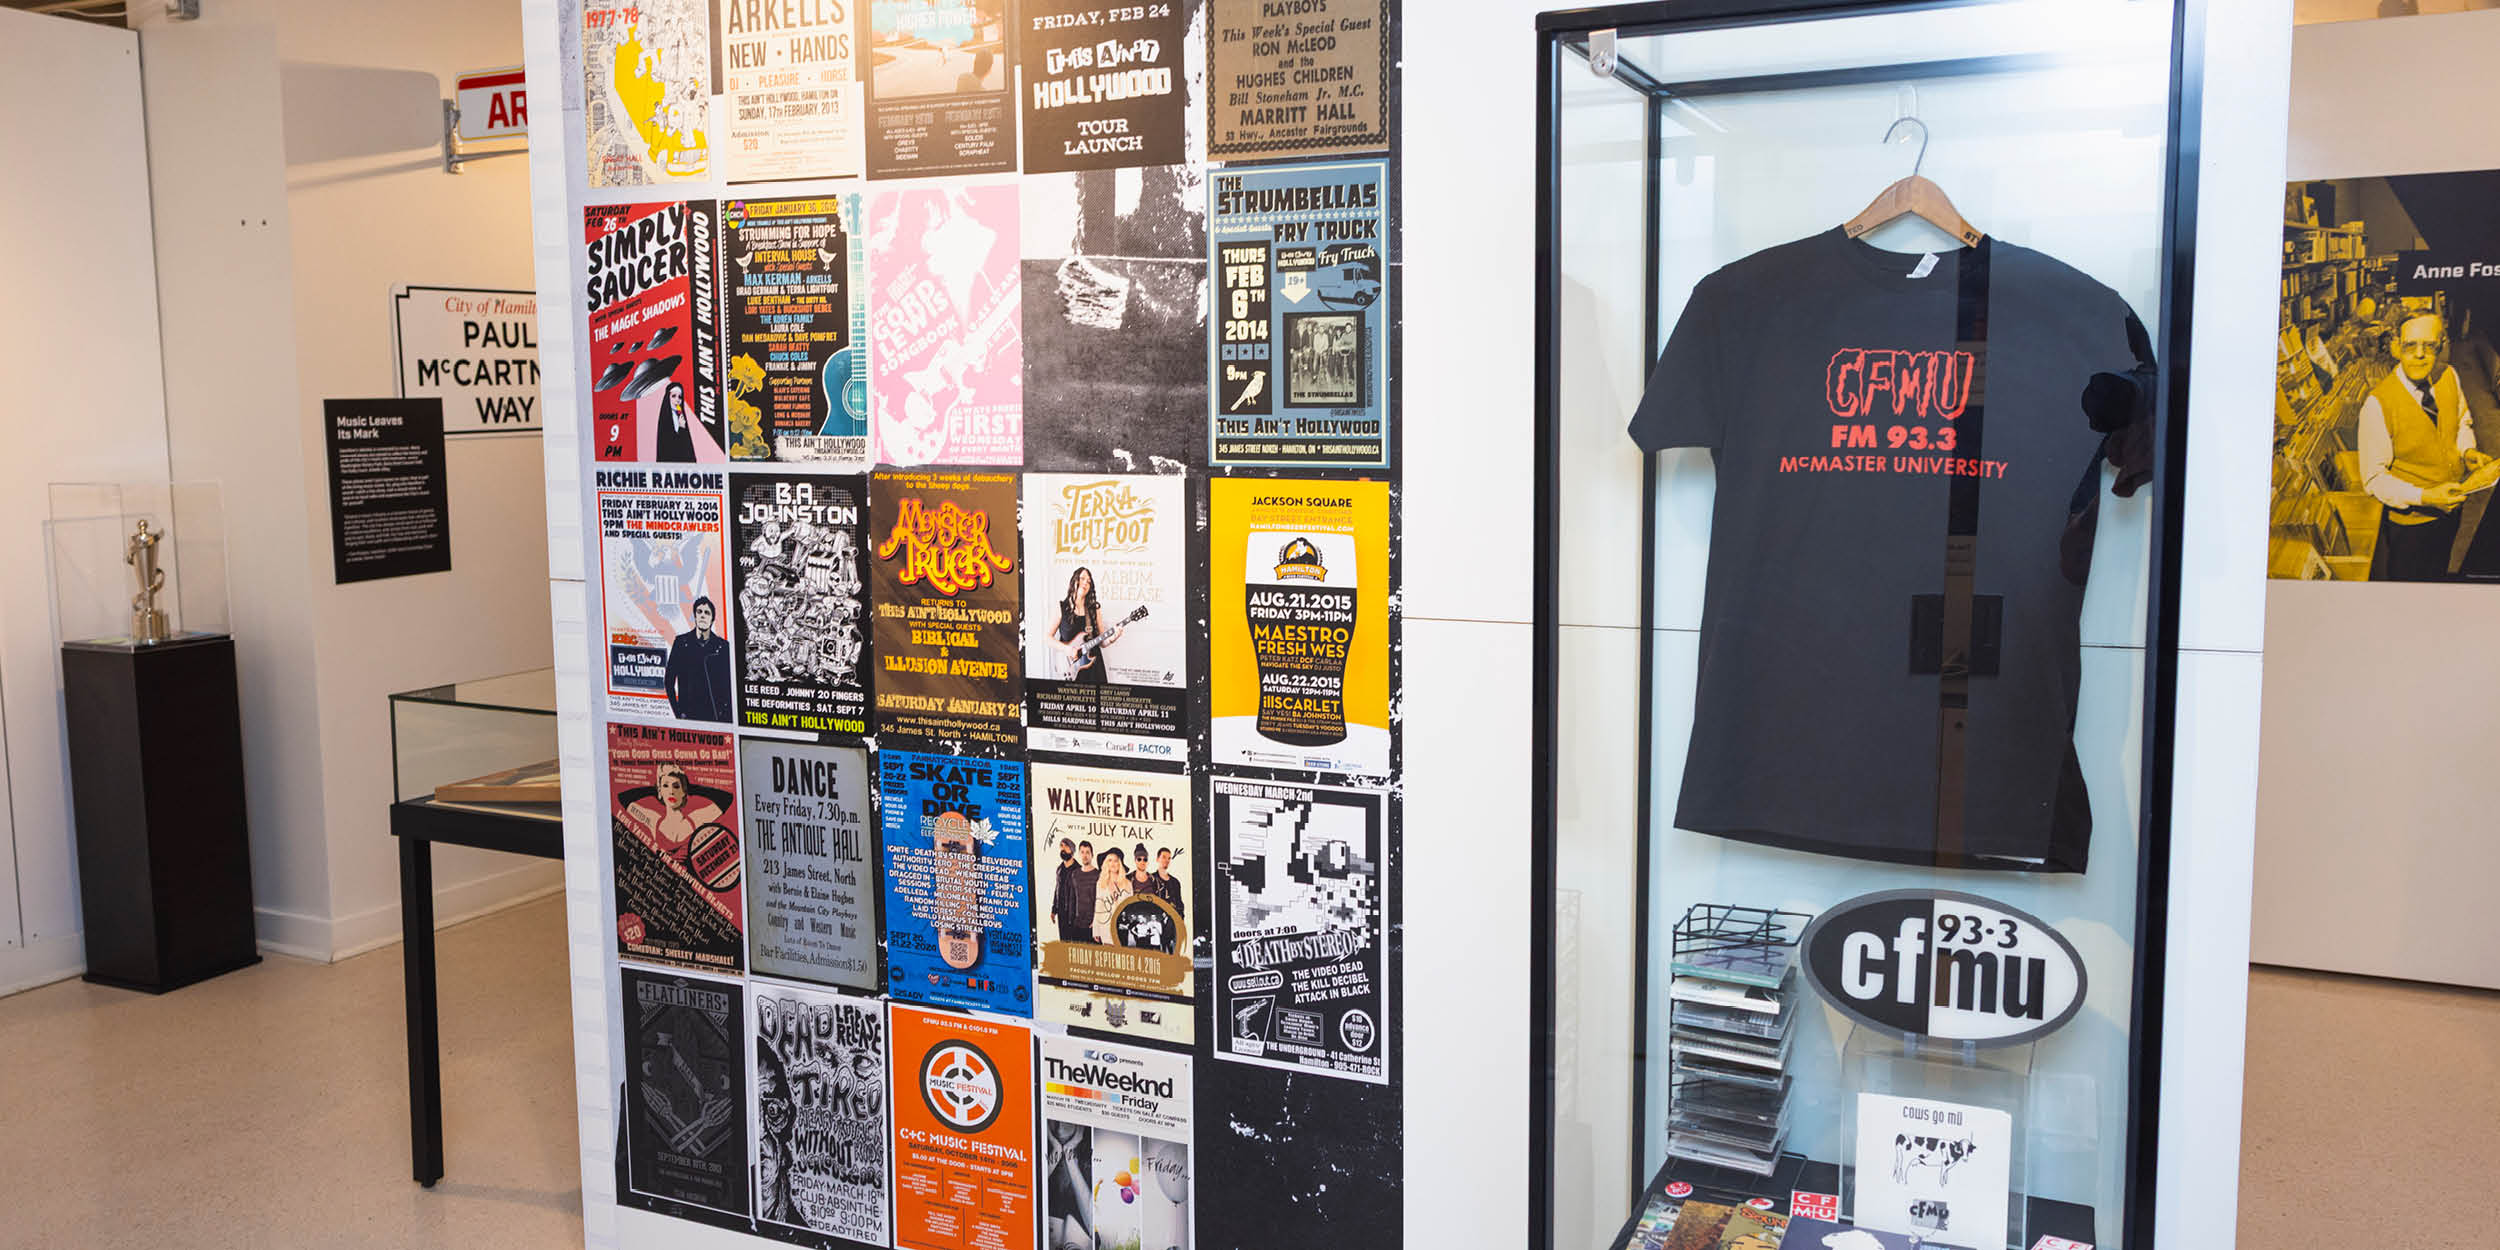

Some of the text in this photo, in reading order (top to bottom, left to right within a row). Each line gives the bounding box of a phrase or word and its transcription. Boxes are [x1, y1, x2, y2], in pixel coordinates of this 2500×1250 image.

[729, 0, 846, 34] ARKELLS
[1033, 4, 1171, 30] FRIDAY, FEB 24
[1263, 0, 1327, 17] PLAYBOYS
[1222, 18, 1371, 42] This Week's Special Guest
[729, 34, 849, 69] NEW HANDS
[1252, 37, 1336, 57] RON McLEOD
[1236, 66, 1353, 89] HUGHES CHILDREN
[1033, 67, 1172, 110] HOLLYWOOD
[1229, 90, 1309, 107] Bill Stoneham
[1240, 103, 1355, 126] MARRITT HALL
[1063, 118, 1143, 155] TOUR LAUNCH
[1269, 121, 1368, 138] Ancaster Fairgrounds
[1218, 176, 1379, 216] THE STRUMBELLAS
[588, 204, 684, 275] SIMPLY
[739, 224, 837, 241] STRUMMING HOPE
[1274, 221, 1310, 243] FRY
[1315, 218, 1379, 241] TRUCK
[1223, 247, 1266, 264] THURS
[1318, 245, 1375, 267] Fry Truck
[588, 242, 687, 313] SAUCER
[692, 211, 713, 328] HOLLYWOOD
[744, 272, 802, 286] MAX KERMAN
[1226, 264, 1264, 288] FEB
[2413, 264, 2464, 279] Anne
[444, 297, 472, 317] City
[477, 301, 490, 317] of
[642, 292, 685, 325] SHADOWS
[464, 320, 537, 349] PAUL
[1225, 320, 1268, 341] 2014
[1826, 347, 1975, 420] CFMU
[475, 396, 535, 424] WAY
[337, 415, 403, 427] Music Leaves
[353, 428, 379, 439] Mark
[1831, 424, 1957, 451] FM 93.3
[1894, 456, 2009, 478] UNIVERSITY
[596, 471, 723, 490] RICHIE RAMONE
[602, 499, 718, 512] FRIDAY FEBRUARY 2014
[1251, 496, 1353, 508] JACKSON SQUARE
[602, 508, 719, 522] THIS HOLLYWOOD
[739, 503, 858, 525] JOHNSTON
[603, 519, 719, 533] 9PM THE MINDCRAWLERS
[1249, 592, 1352, 611] AUG.21.2015
[938, 606, 1012, 624] HOLLYWOOD
[1250, 608, 1352, 623] FRIDAY 3PM-11PM
[911, 630, 978, 648] BIBLICAL
[1253, 623, 1350, 644] MAESTRO
[1258, 640, 1345, 658] FRESH WES
[884, 655, 1009, 680] ILLUSION AVENUE
[1262, 673, 1341, 689] AUG.22.2015
[1263, 685, 1300, 694] SATURDAY
[760, 685, 864, 702] REED JOHNNY FINGERS
[762, 699, 811, 712] DEFORMITIES
[876, 693, 1006, 716] SATURDAY JANUARY
[746, 711, 865, 734] THIS AIN'T HOLLYWOOD
[1138, 743, 1172, 755] FACTOR
[771, 755, 839, 800] DANCE
[909, 762, 993, 788] SKATE
[932, 783, 969, 803] OR
[1214, 782, 1295, 800] WEDNESDAY MARCH
[755, 794, 780, 818] Every
[1047, 787, 1174, 823] WALK OFF EARTH
[756, 818, 863, 864] THE ANTIQUE HALL
[1087, 822, 1154, 840] JULY TALK
[981, 855, 1023, 868] BELVEDERE
[763, 859, 857, 887] 213 James North
[1234, 925, 1298, 939] doors at 7:00
[1291, 961, 1363, 981] THE VIDEO DEAD
[1291, 973, 1369, 993] THE KILL DECIBEL
[645, 985, 722, 1011] FLATLINERS
[1294, 984, 1371, 1005] ATTACK IN BLACK
[929, 1078, 993, 1096] MUSIC FESTIVAL
[1044, 1056, 1173, 1099] TheWeeknd
[1121, 1095, 1159, 1114] Friday
[1903, 1105, 1929, 1121] cows
[1932, 1109, 1944, 1125] go
[930, 1132, 968, 1151] MUSIC
[800, 1189, 825, 1206] CLUB
